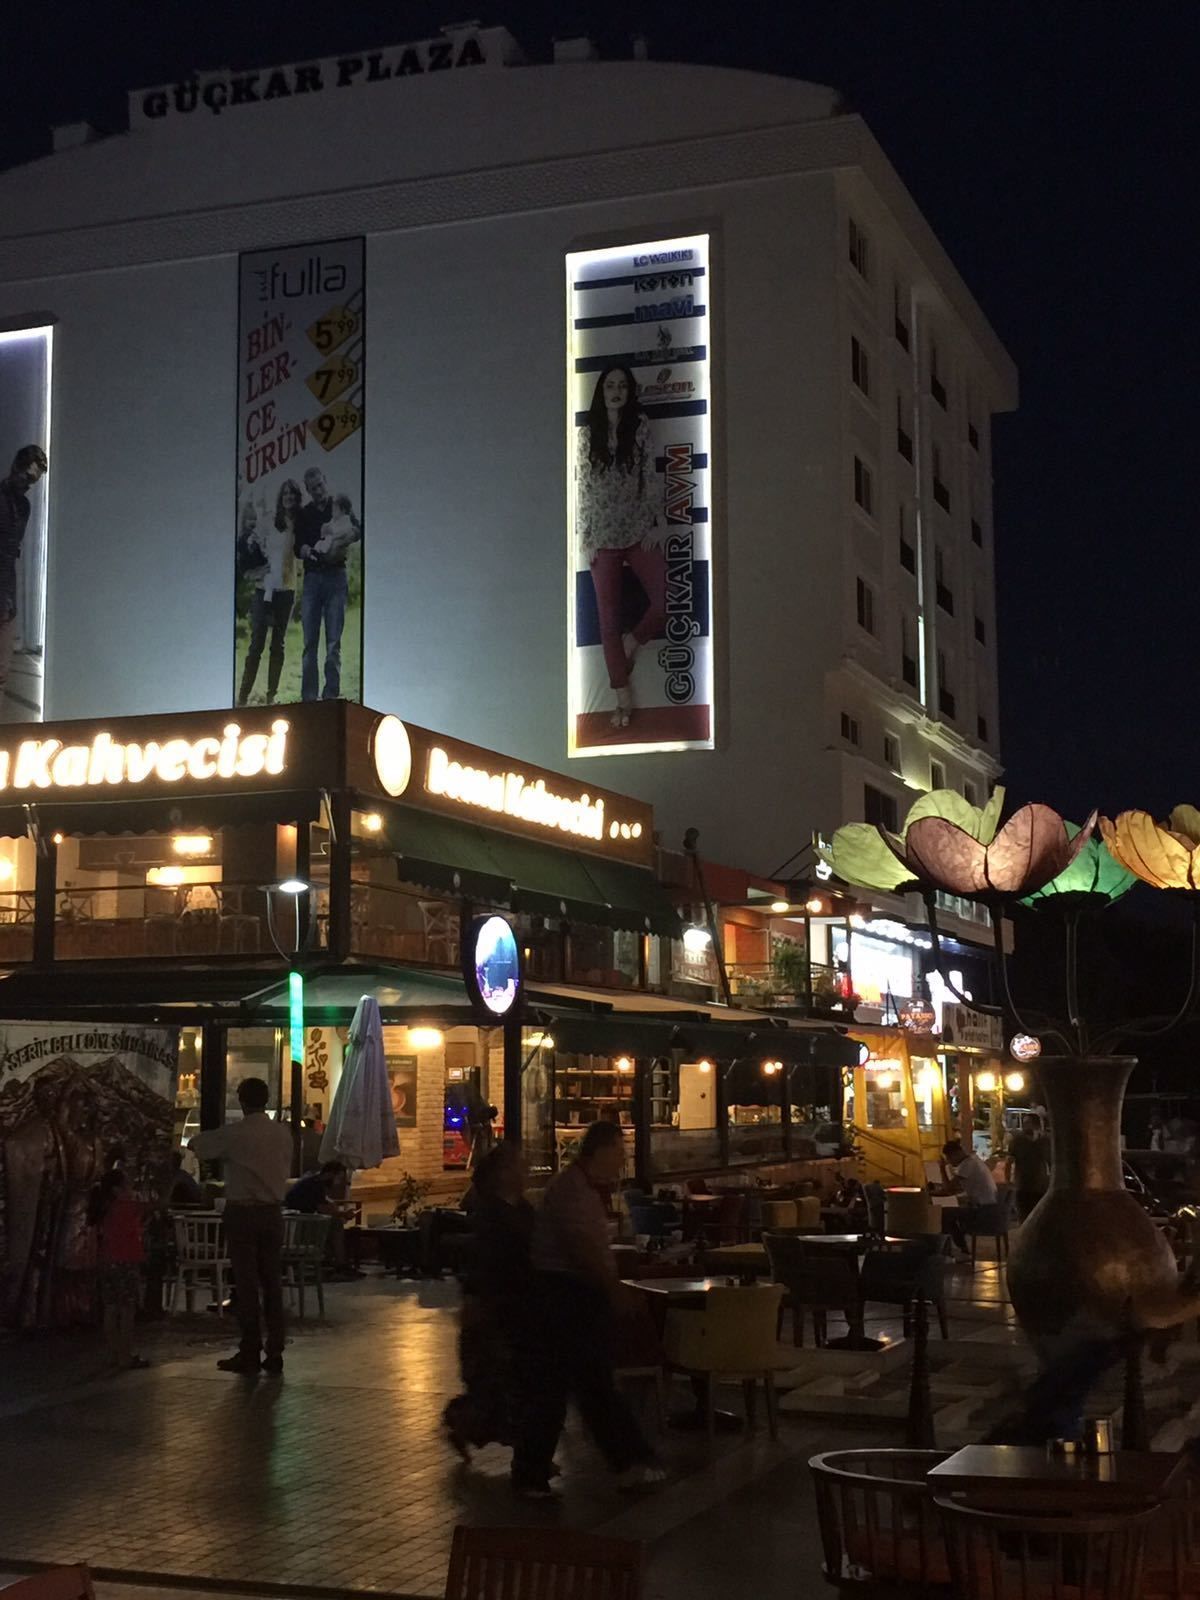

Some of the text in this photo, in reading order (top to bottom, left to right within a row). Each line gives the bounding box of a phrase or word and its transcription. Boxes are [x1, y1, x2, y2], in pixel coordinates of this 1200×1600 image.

[143, 38, 486, 118] GÜÇKAR PLAZA
[270, 257, 347, 300] fulla
[634, 294, 694, 321] mavi
[245, 400, 277, 444] CE
[245, 420, 309, 484] ÜRÜN
[658, 443, 700, 705] GÜÇKAR AVM
[14, 719, 289, 789] Kahvecisi
